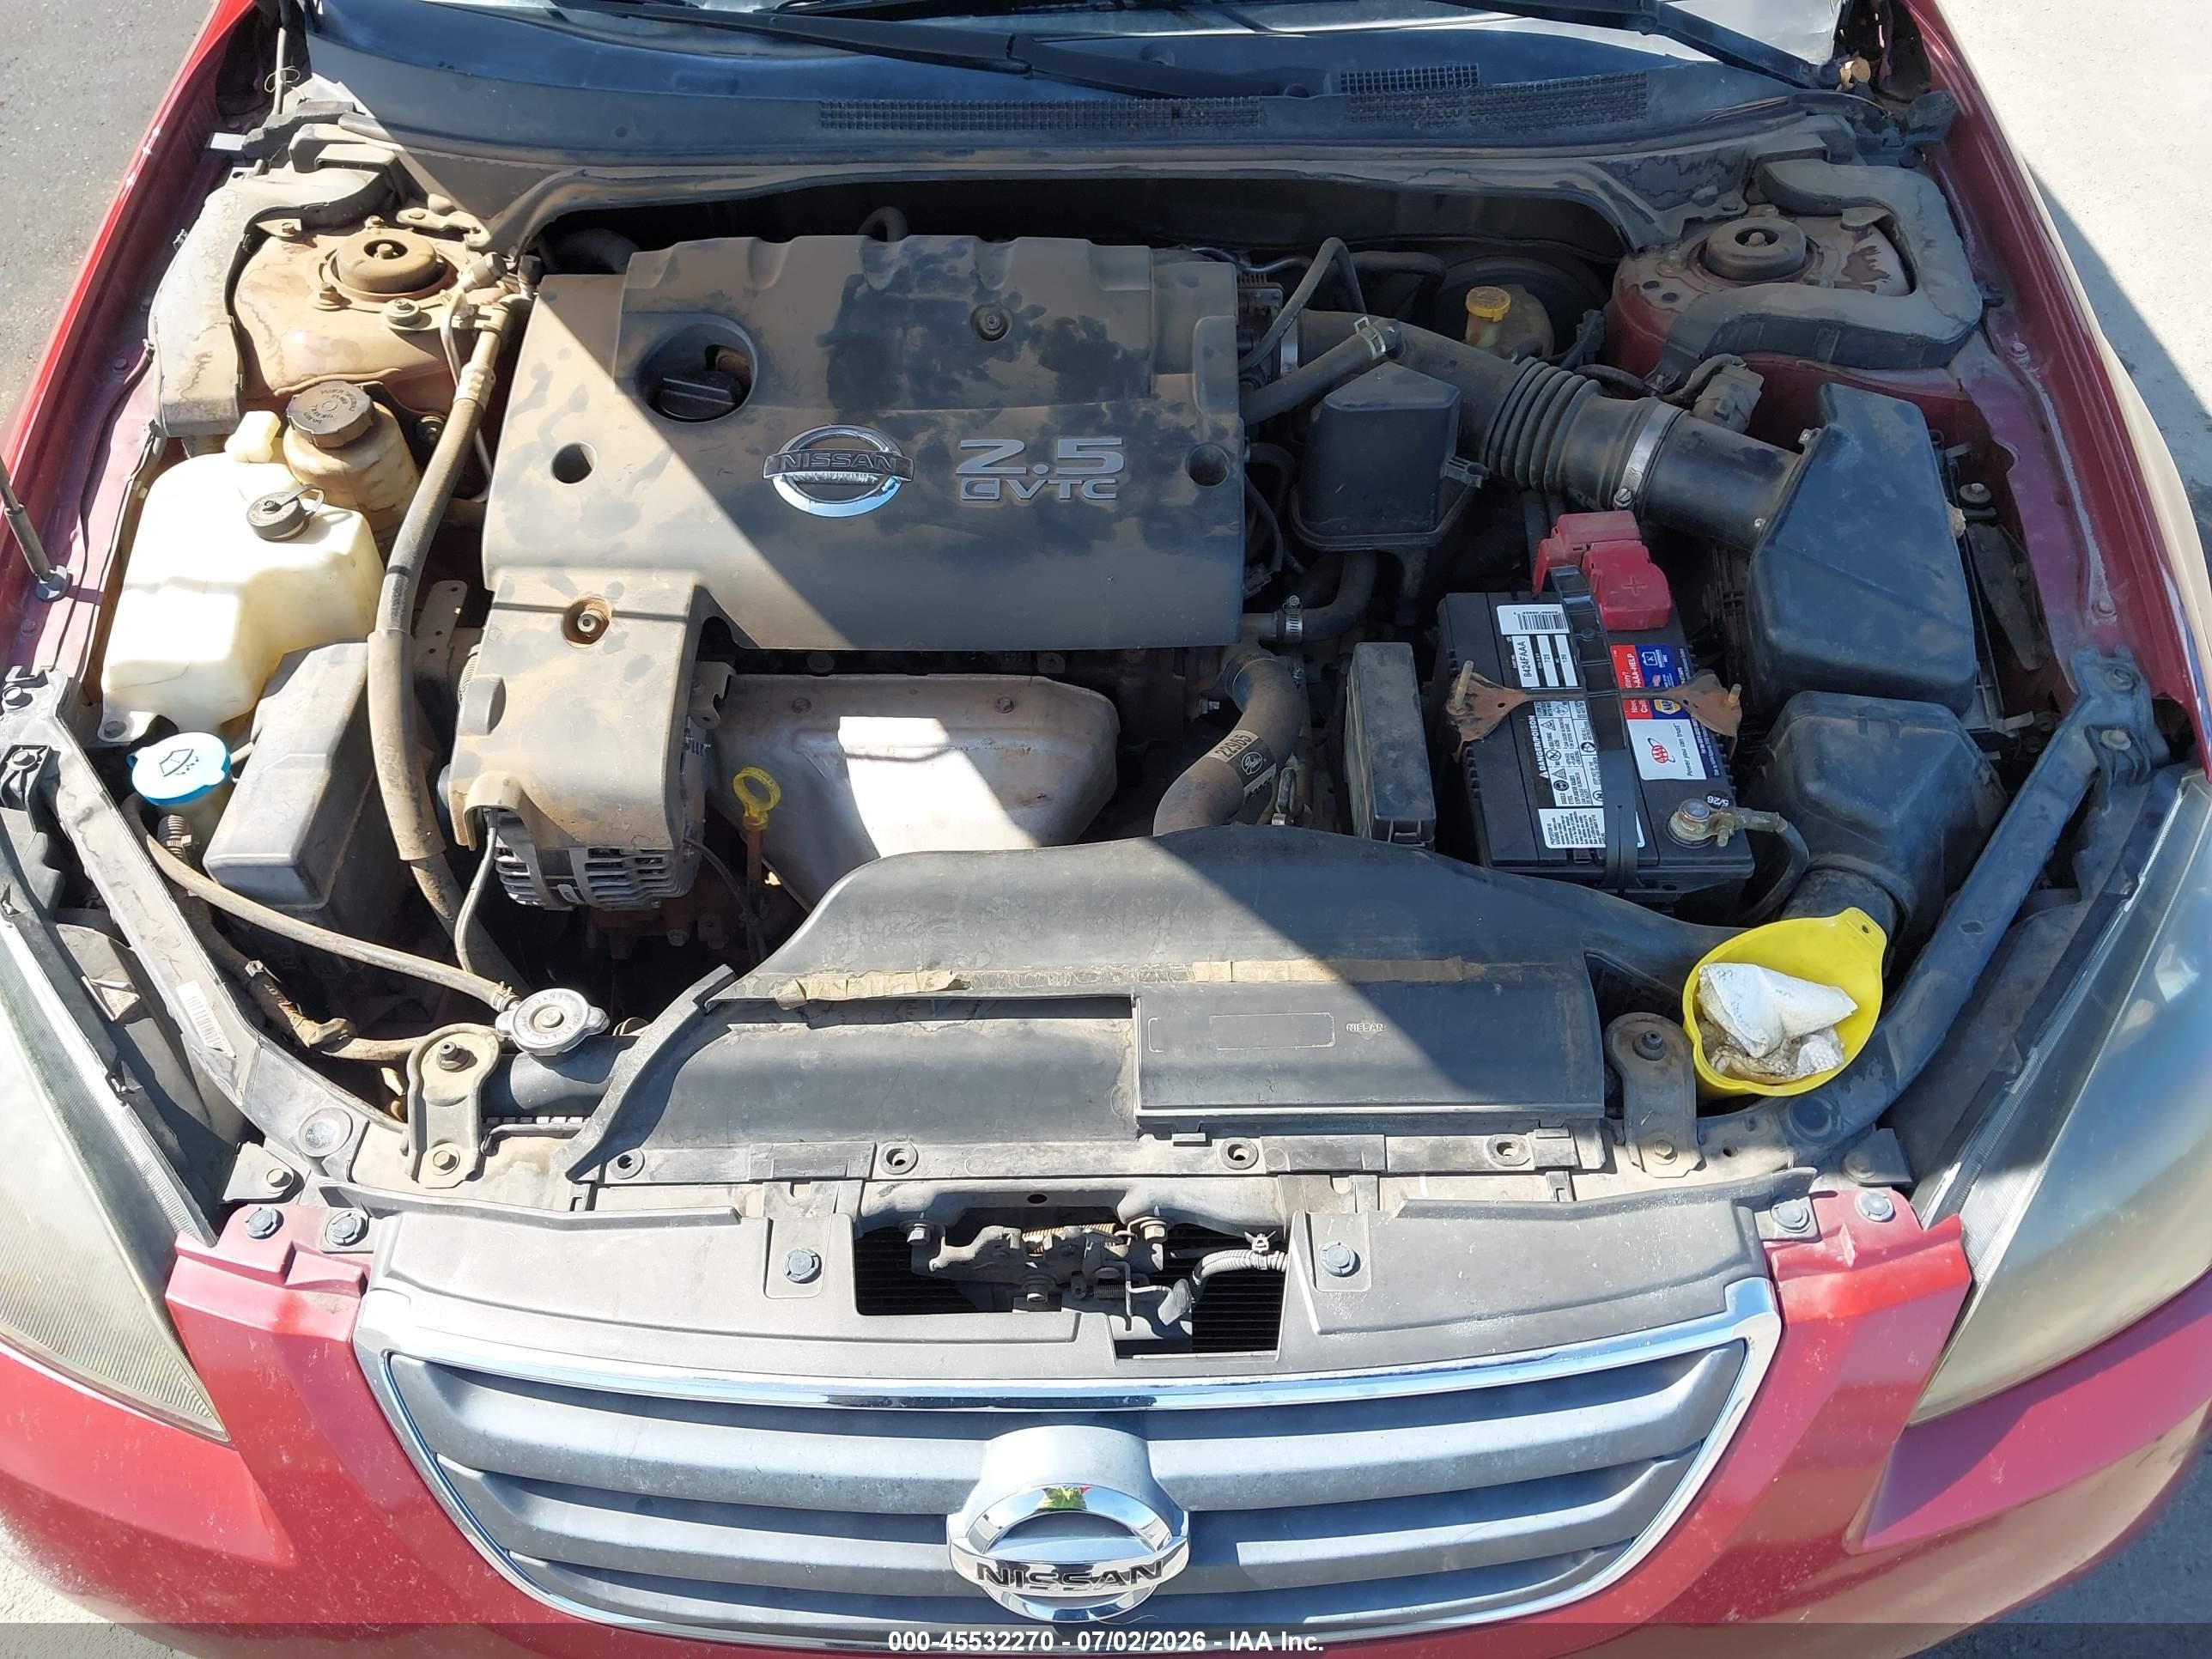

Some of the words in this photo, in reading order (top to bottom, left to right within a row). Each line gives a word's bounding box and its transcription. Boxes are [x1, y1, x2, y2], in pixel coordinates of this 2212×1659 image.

[781, 452, 896, 471] NISSAN
[955, 438, 1124, 475] 2.5
[1214, 733, 1252, 757] 22965
[1528, 714, 1547, 771] DANGER/POISON
[1685, 760, 1693, 776] Power
[1706, 795, 1729, 807] 5/26
[1346, 1023, 1385, 1031] NISSAN
[976, 1559, 1164, 1592] NISSAN
